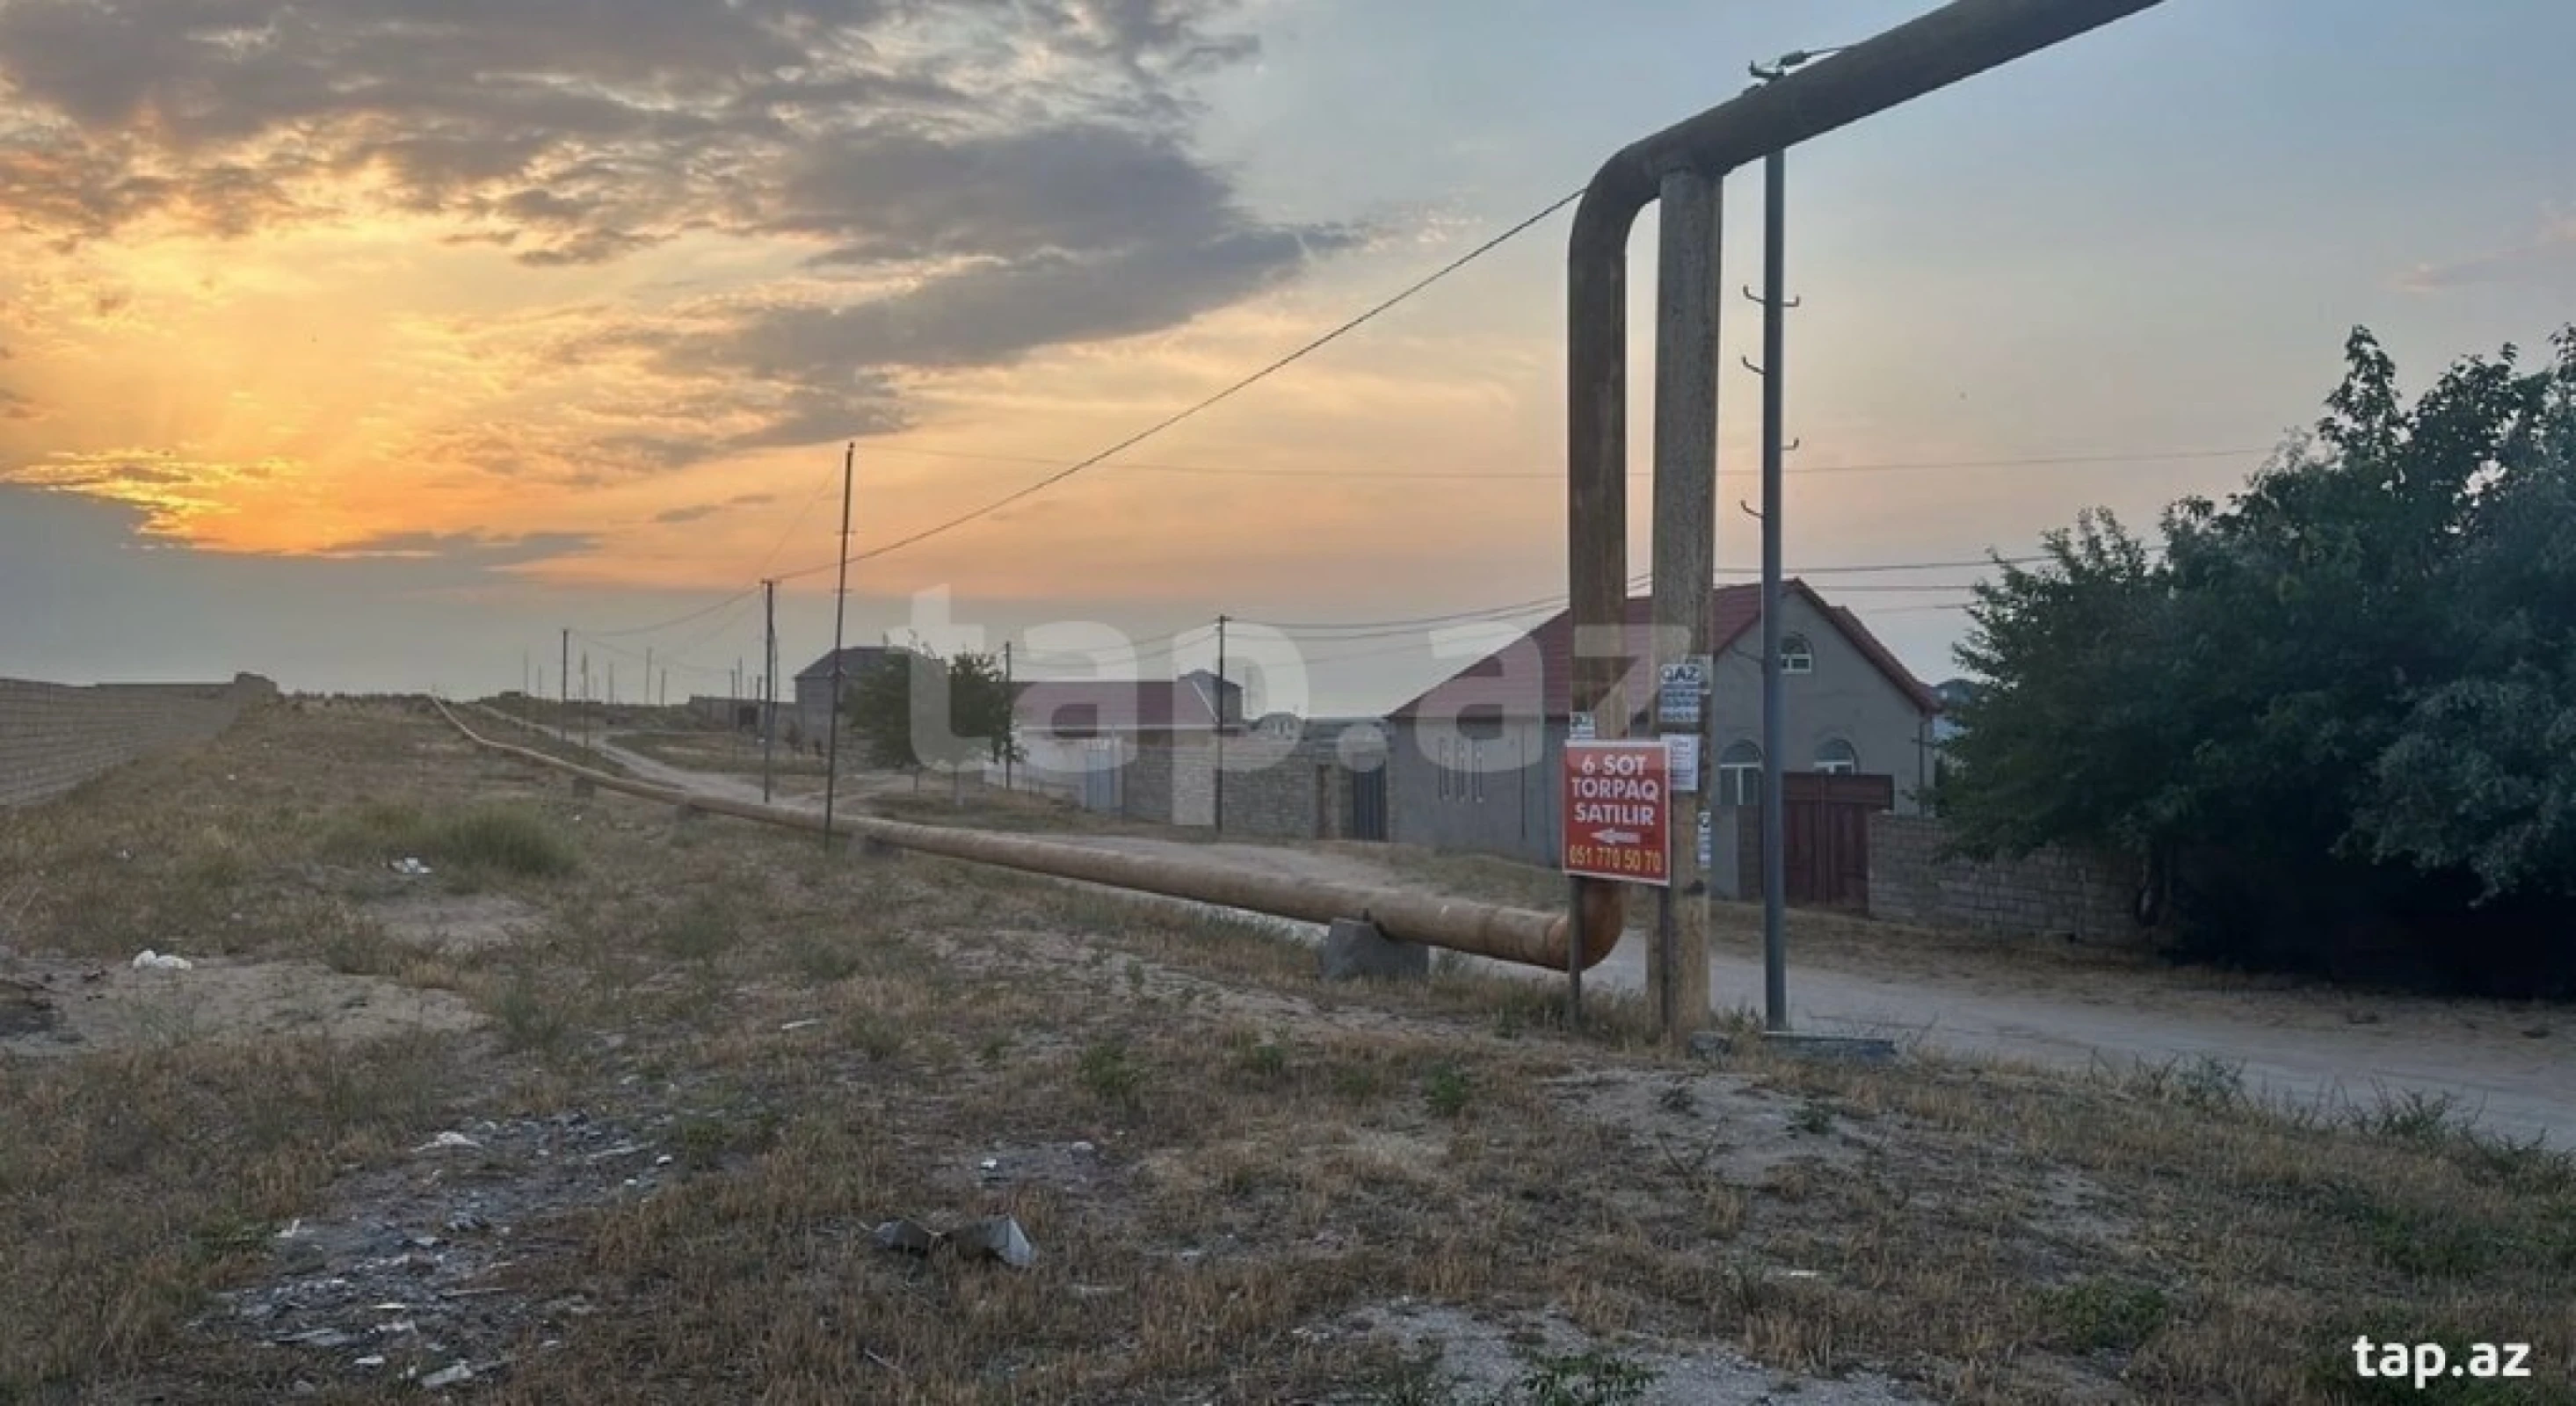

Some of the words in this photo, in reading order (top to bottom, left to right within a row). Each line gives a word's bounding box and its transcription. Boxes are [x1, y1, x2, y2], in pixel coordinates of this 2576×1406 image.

[1582, 754, 1595, 775] 6
[1602, 754, 1646, 776] SOT
[1571, 776, 1658, 805] TORPAQ
[1574, 802, 1655, 826] SATILIR
[1569, 844, 1593, 866] 051
[1596, 847, 1621, 869] 770
[1624, 847, 1641, 871] 50
[1644, 849, 1662, 873] 70
